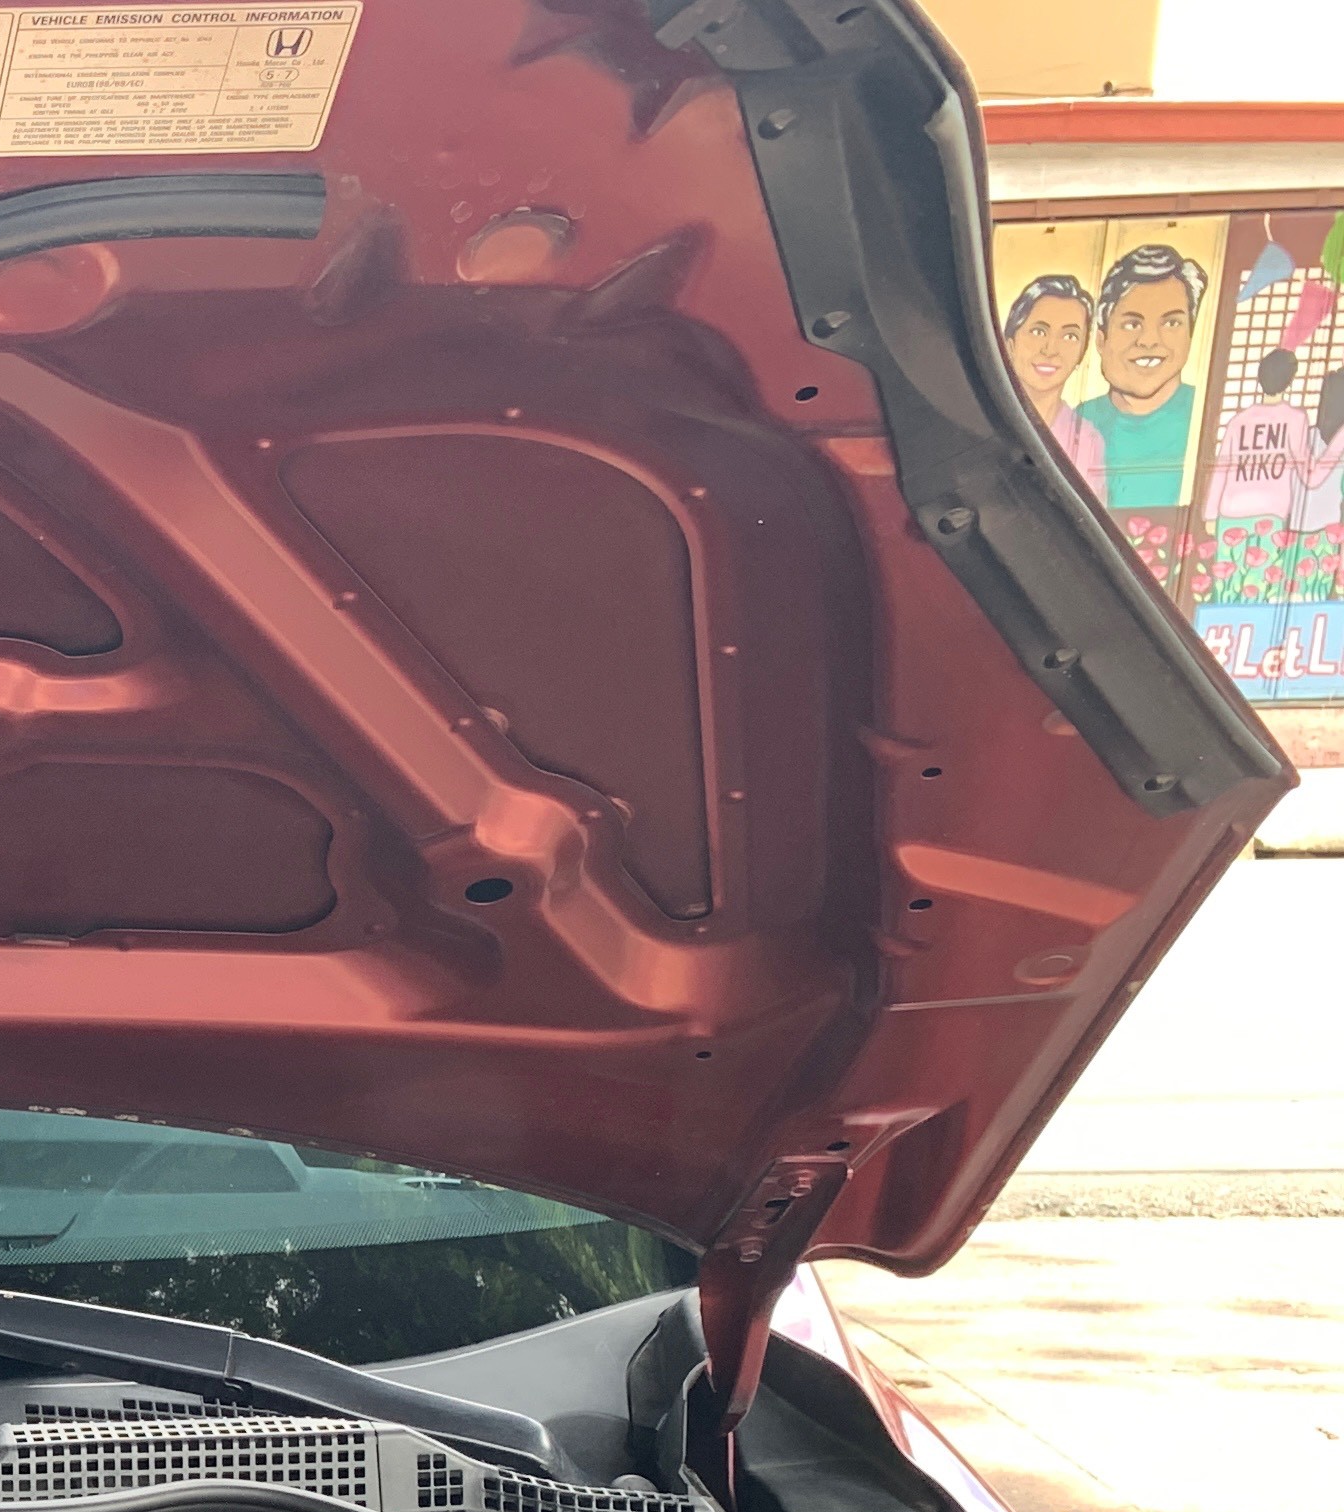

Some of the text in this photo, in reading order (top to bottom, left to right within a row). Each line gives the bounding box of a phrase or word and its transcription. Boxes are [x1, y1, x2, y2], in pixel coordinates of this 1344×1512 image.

[32, 10, 344, 26] VEHICLE EMISSION CONTROL INFORMATION
[1239, 422, 1288, 450] LENI
[1235, 452, 1287, 483] KIKO
